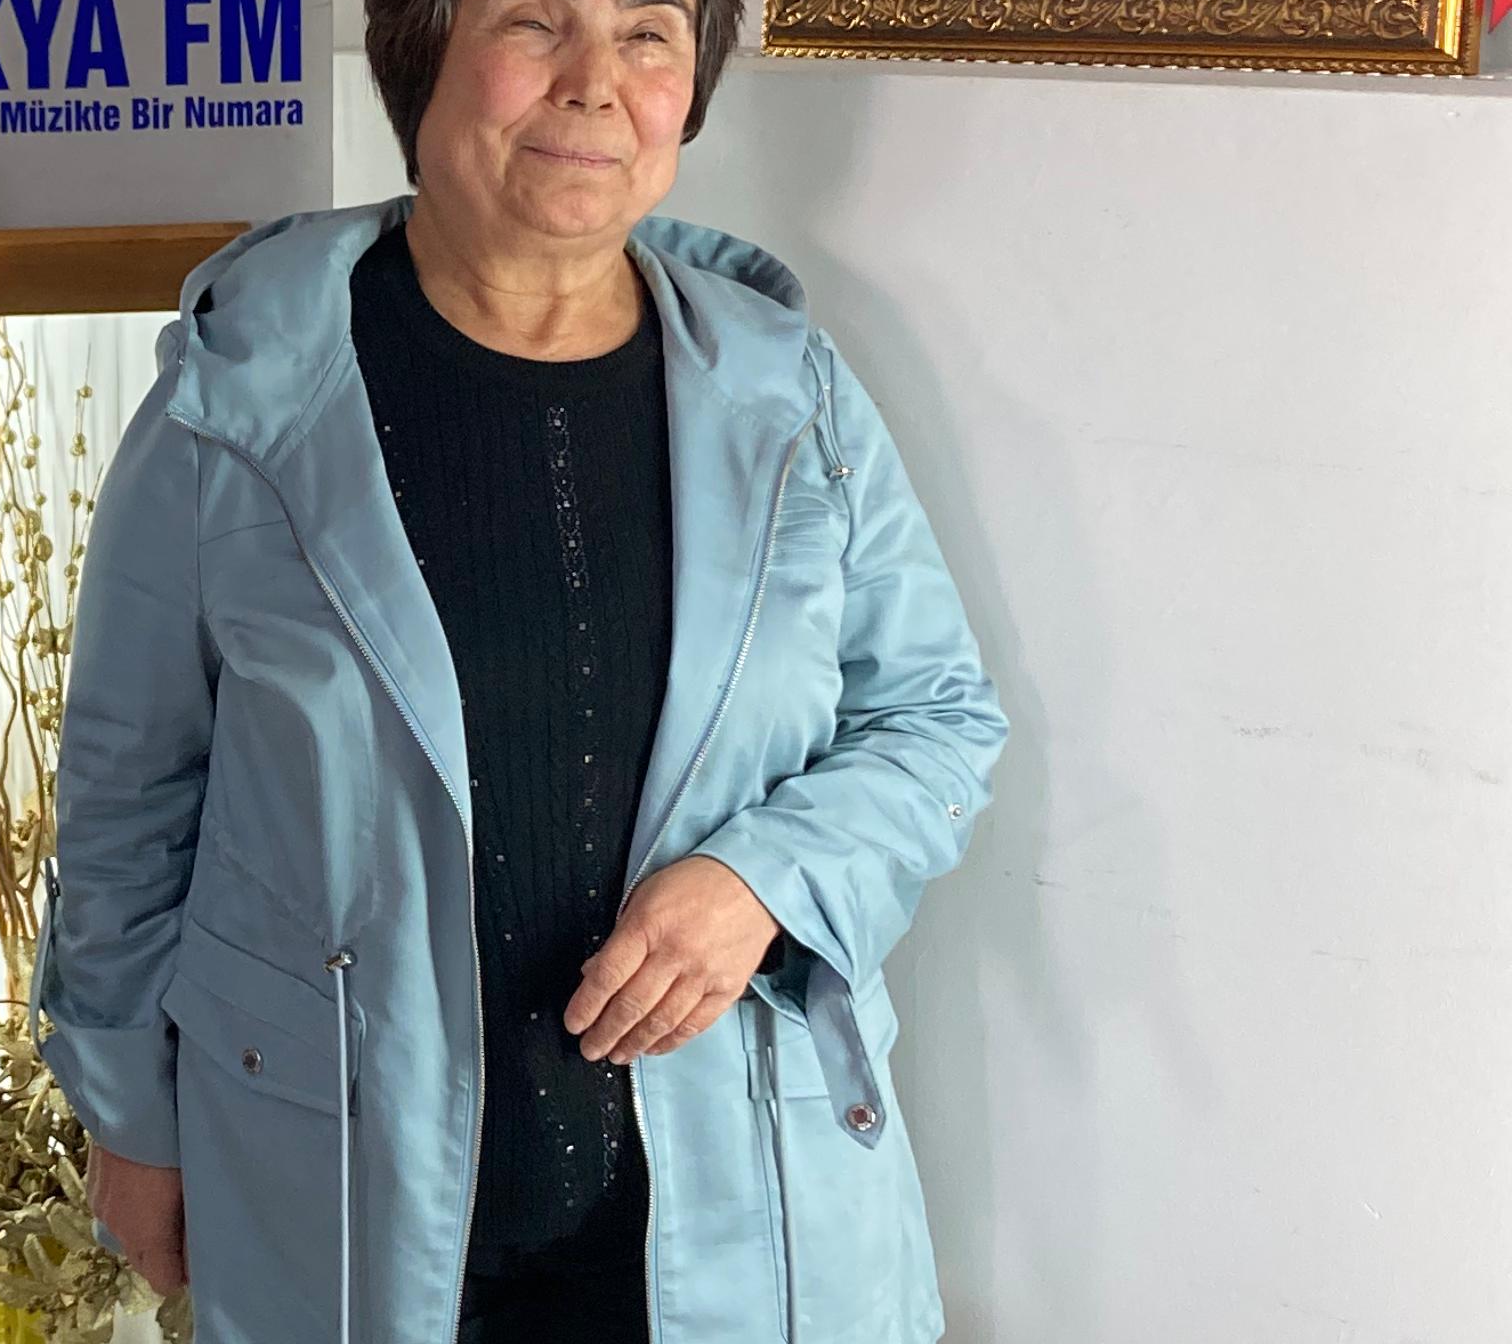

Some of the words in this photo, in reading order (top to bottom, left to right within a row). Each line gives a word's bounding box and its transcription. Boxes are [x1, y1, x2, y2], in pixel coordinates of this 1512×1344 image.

[0, 99, 121, 133] Müzikte
[131, 97, 174, 130] Bir
[184, 96, 304, 129] Numara
